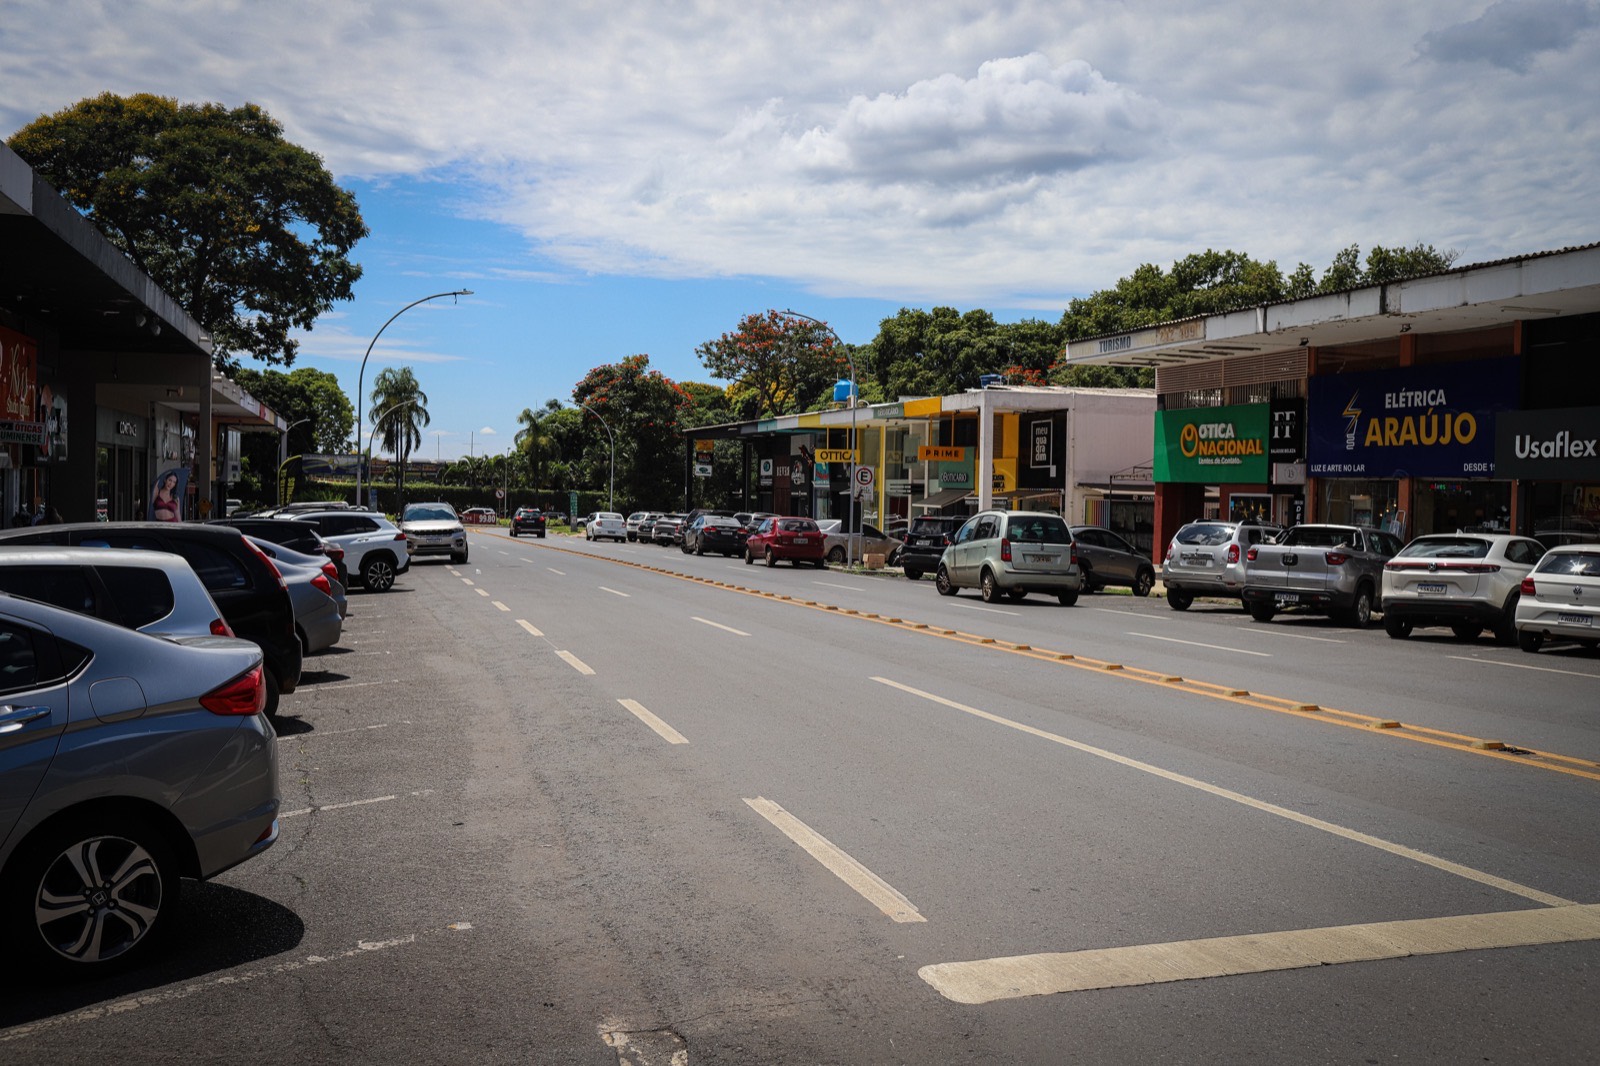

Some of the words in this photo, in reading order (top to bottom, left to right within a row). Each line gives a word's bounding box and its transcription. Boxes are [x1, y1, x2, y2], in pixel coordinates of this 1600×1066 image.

[1099, 336, 1132, 353] TURISMO
[1385, 387, 1446, 409] ELÉTRICA
[1036, 427, 1048, 435] meu
[1364, 407, 1477, 447] ARAÚJO
[1036, 436, 1047, 447] qua
[1515, 431, 1597, 459] Usaflex
[1199, 439, 1264, 456] NACIONAL
[925, 449, 960, 458] PRIME
[1310, 464, 1322, 472] LUZ
[1322, 464, 1327, 472] E
[1327, 464, 1342, 472] ARTE
[1343, 464, 1352, 472] NO
[1353, 464, 1365, 472] LAR
[1463, 462, 1488, 472] DESDE
[860, 471, 869, 482] E
